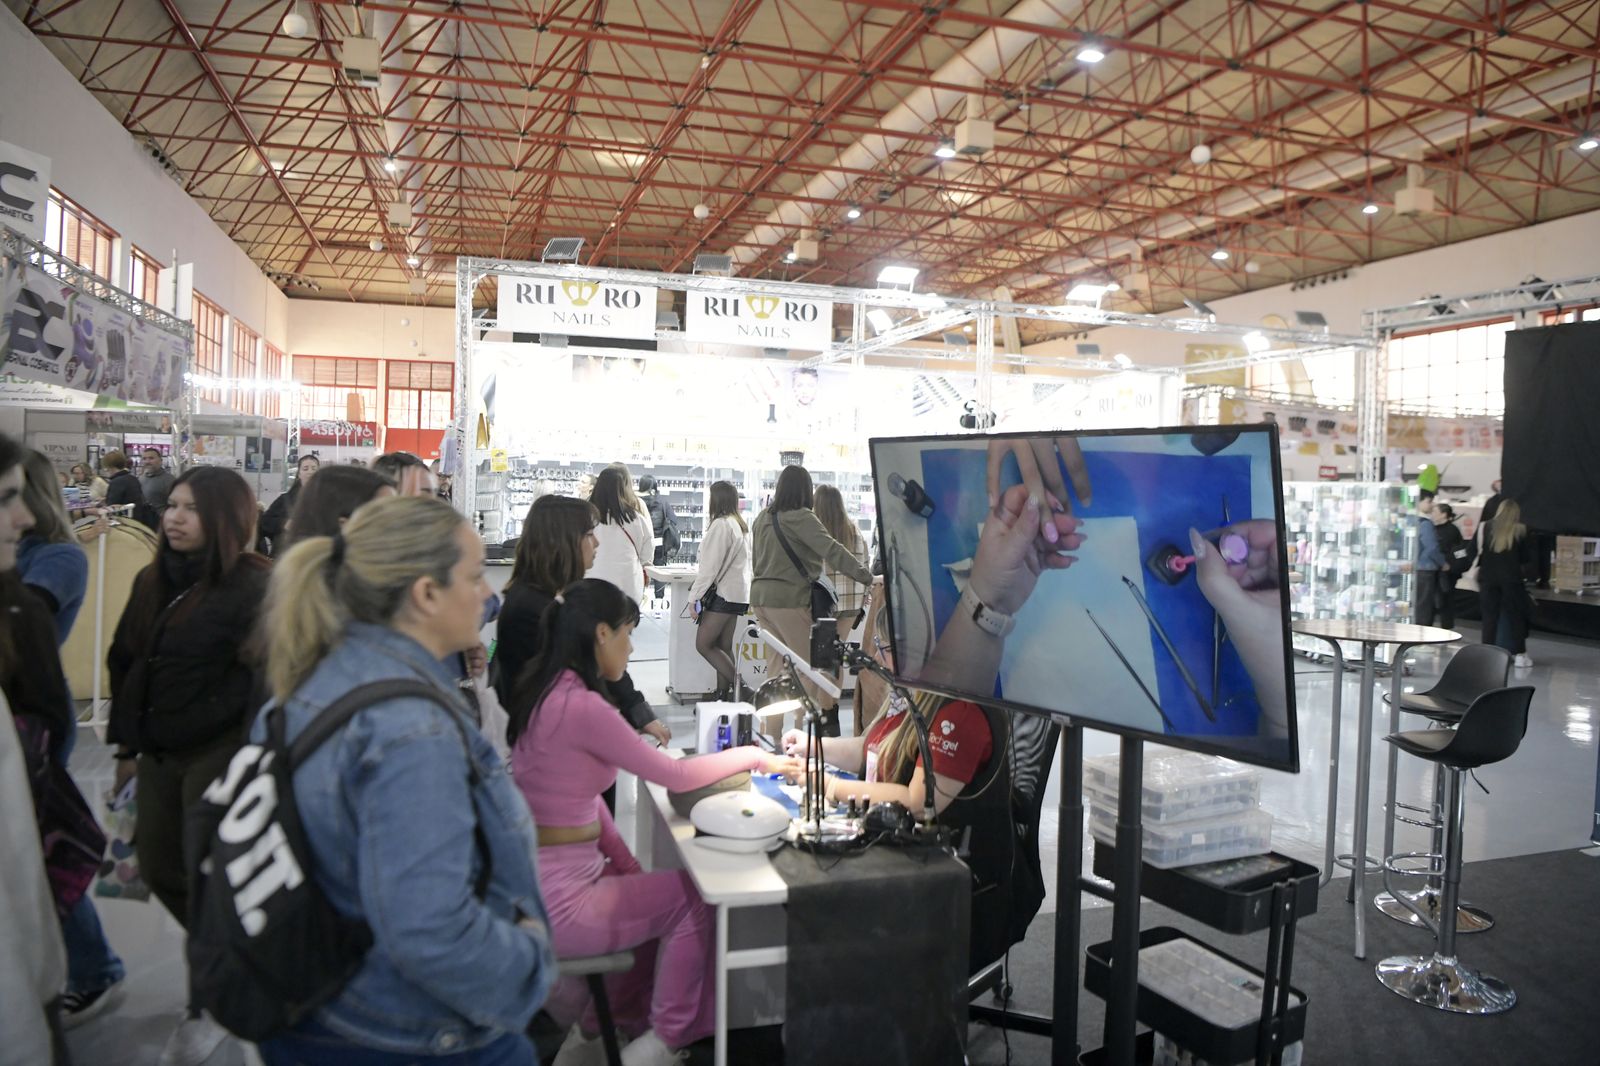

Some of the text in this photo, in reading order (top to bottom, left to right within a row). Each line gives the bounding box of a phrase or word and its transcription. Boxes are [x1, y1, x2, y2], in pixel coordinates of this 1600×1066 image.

[516, 283, 641, 309] RU RO
[553, 311, 611, 327] NAILS
[704, 296, 818, 322] RU RO
[737, 324, 790, 339] NAILS
